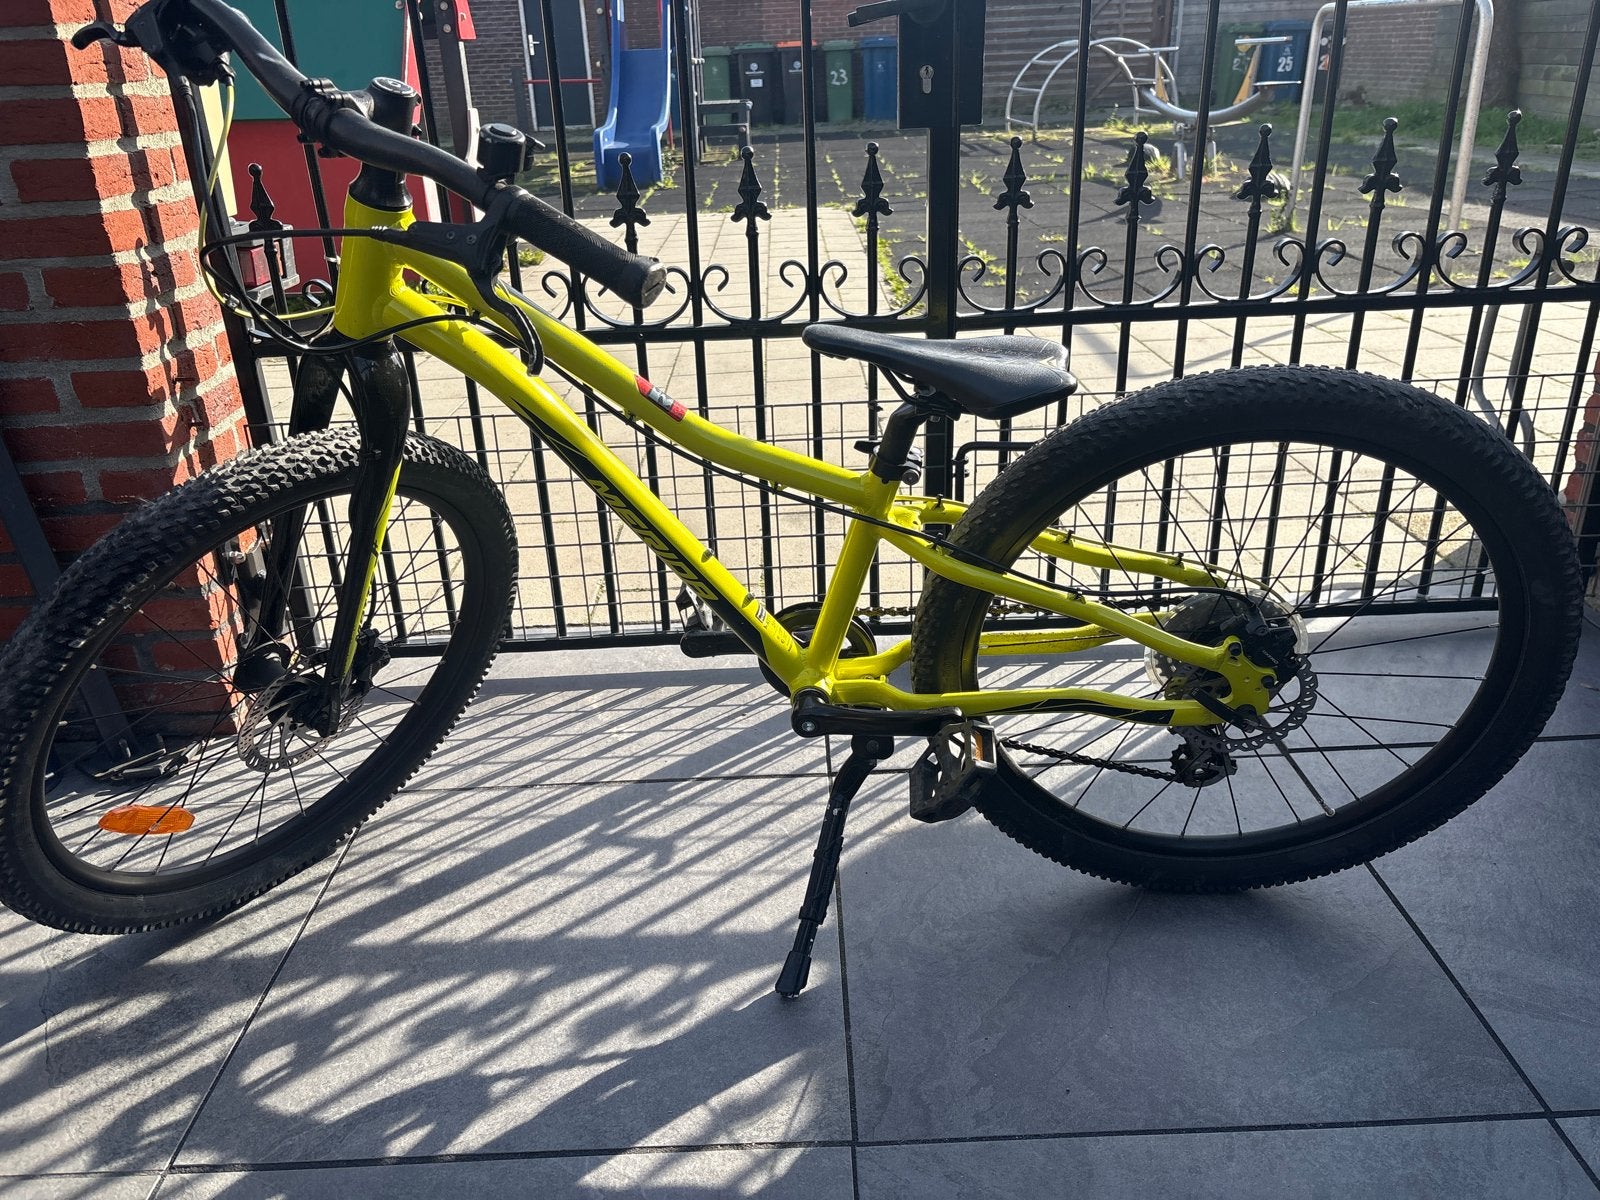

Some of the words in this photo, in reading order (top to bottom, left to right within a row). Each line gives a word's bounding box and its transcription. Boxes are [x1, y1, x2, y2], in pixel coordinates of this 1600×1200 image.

[1277, 56, 1294, 73] 25
[830, 69, 848, 86] 23
[587, 479, 718, 601] MERIDA
